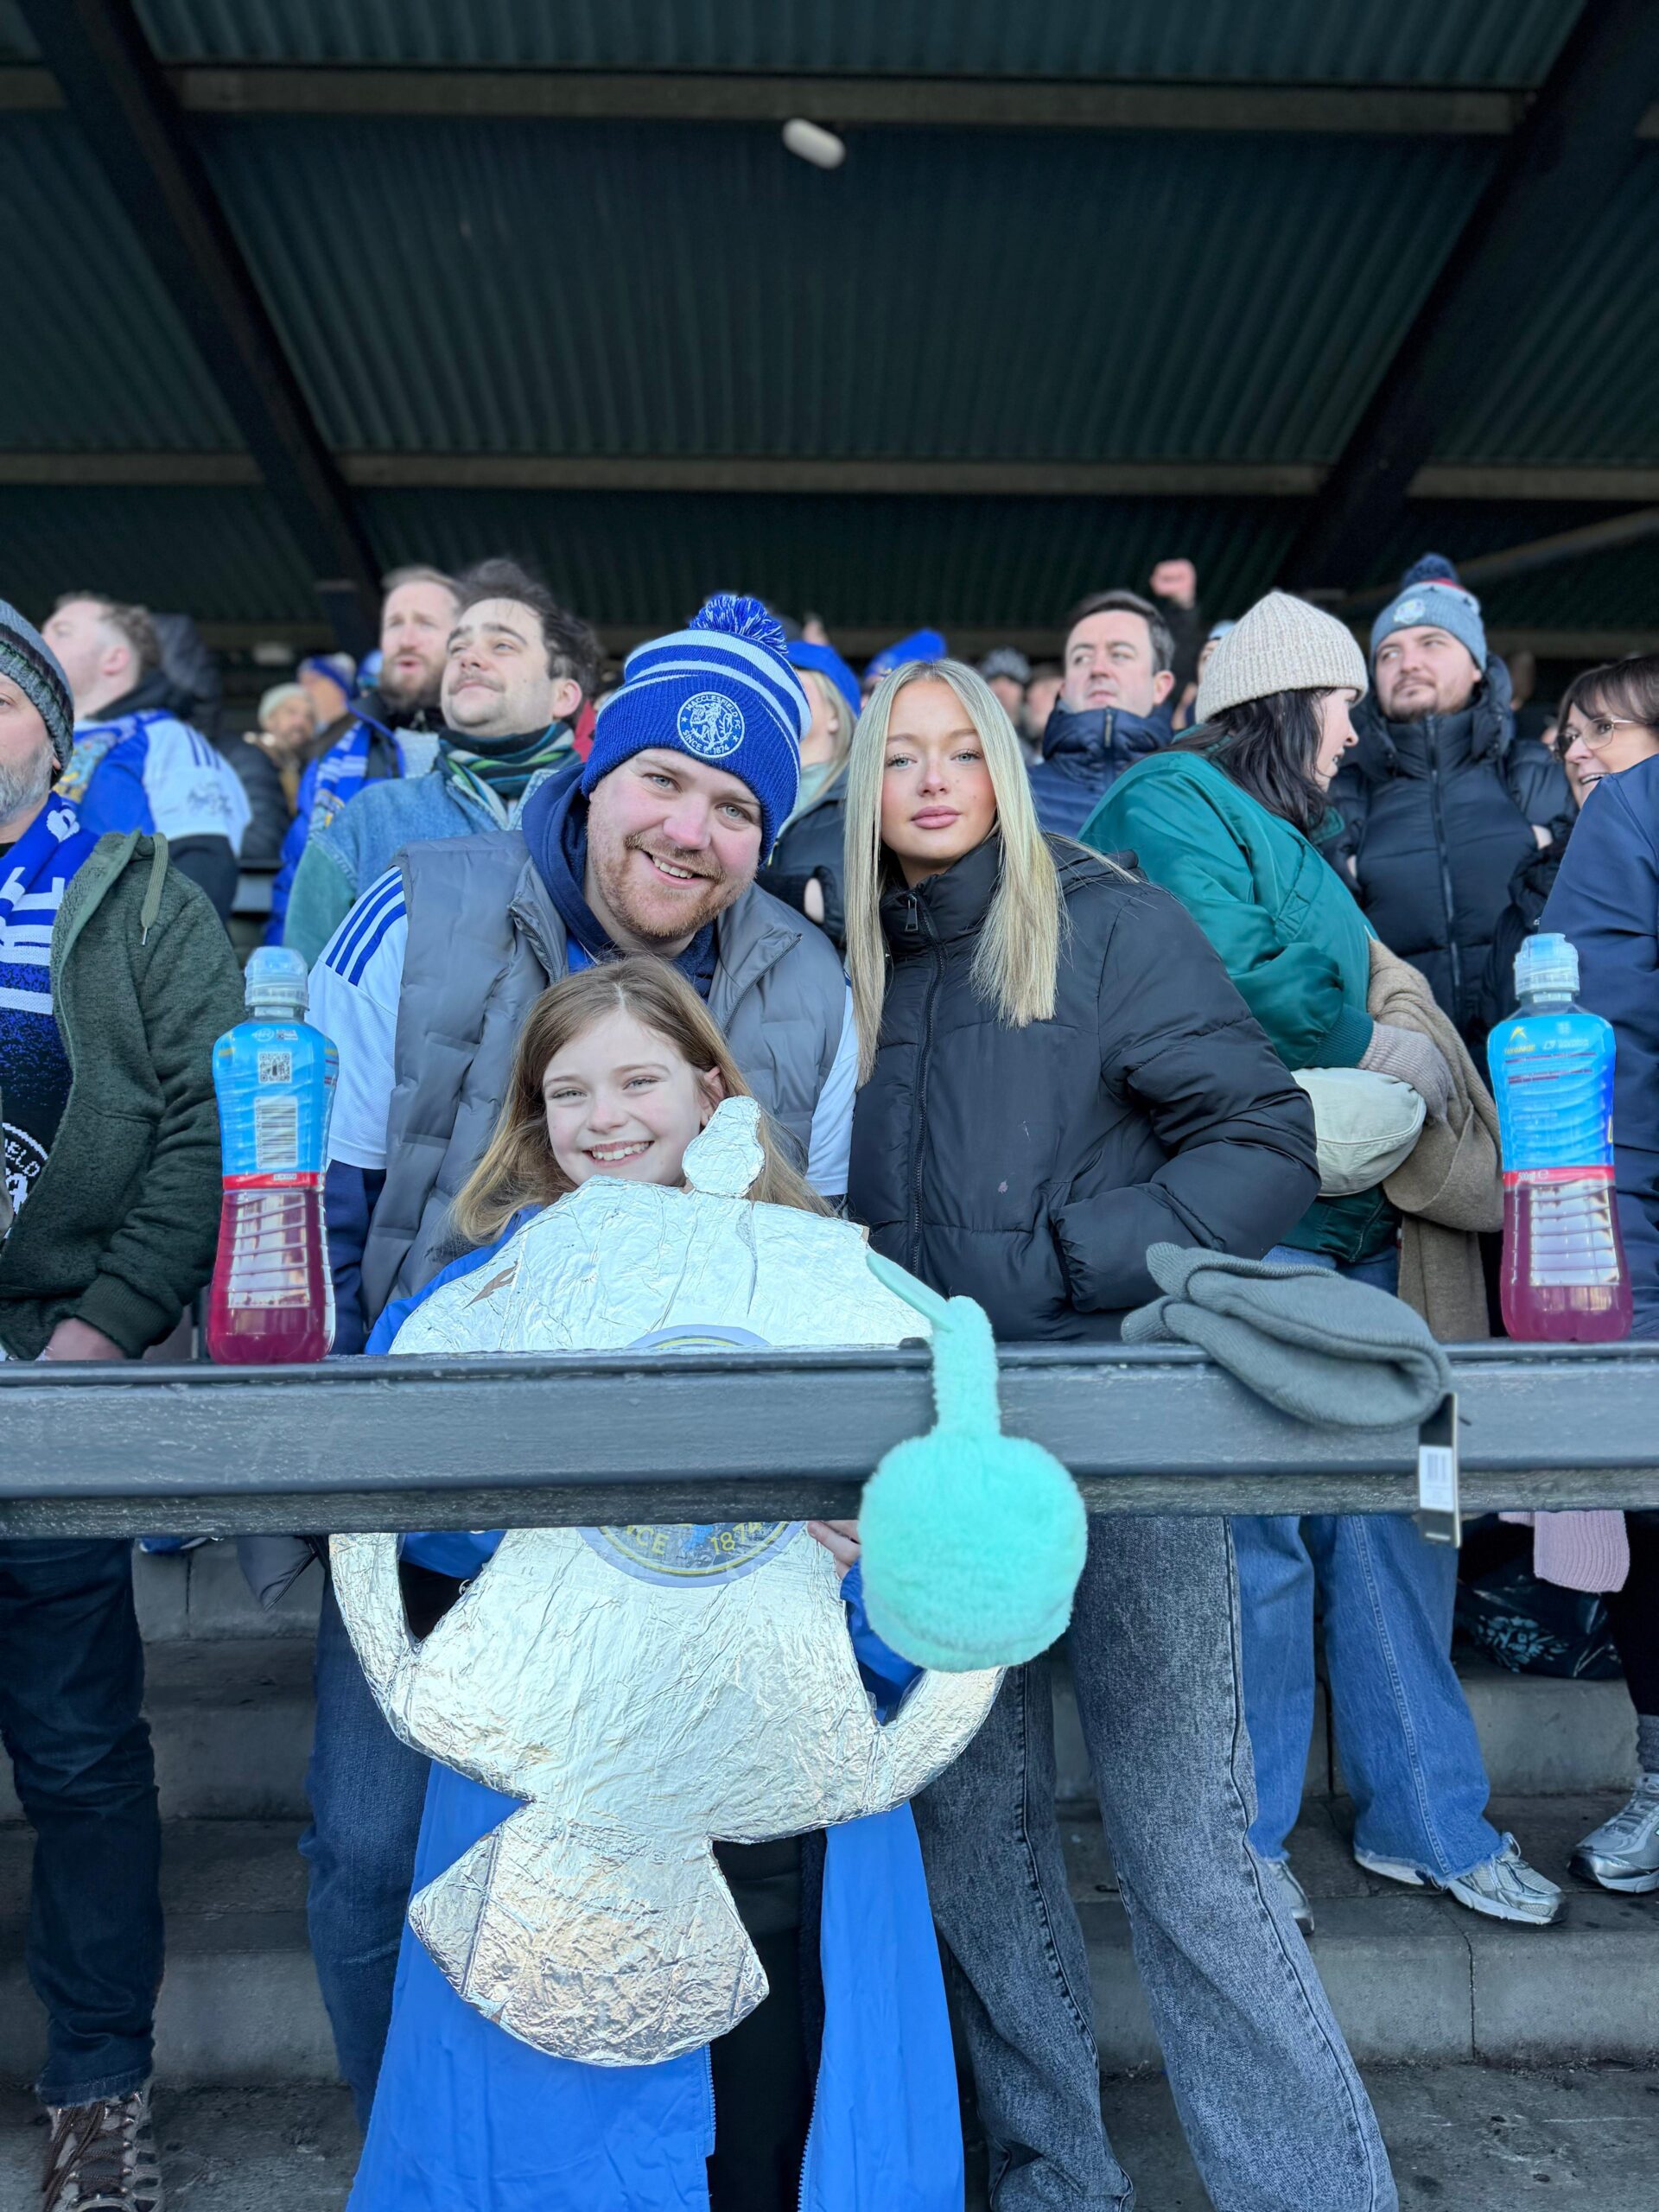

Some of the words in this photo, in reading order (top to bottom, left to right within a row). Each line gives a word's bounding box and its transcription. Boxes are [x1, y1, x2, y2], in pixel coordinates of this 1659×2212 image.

[685, 695, 739, 717] MACCLESFIELD
[734, 718, 741, 730] FC
[683, 729, 702, 751] SINCE
